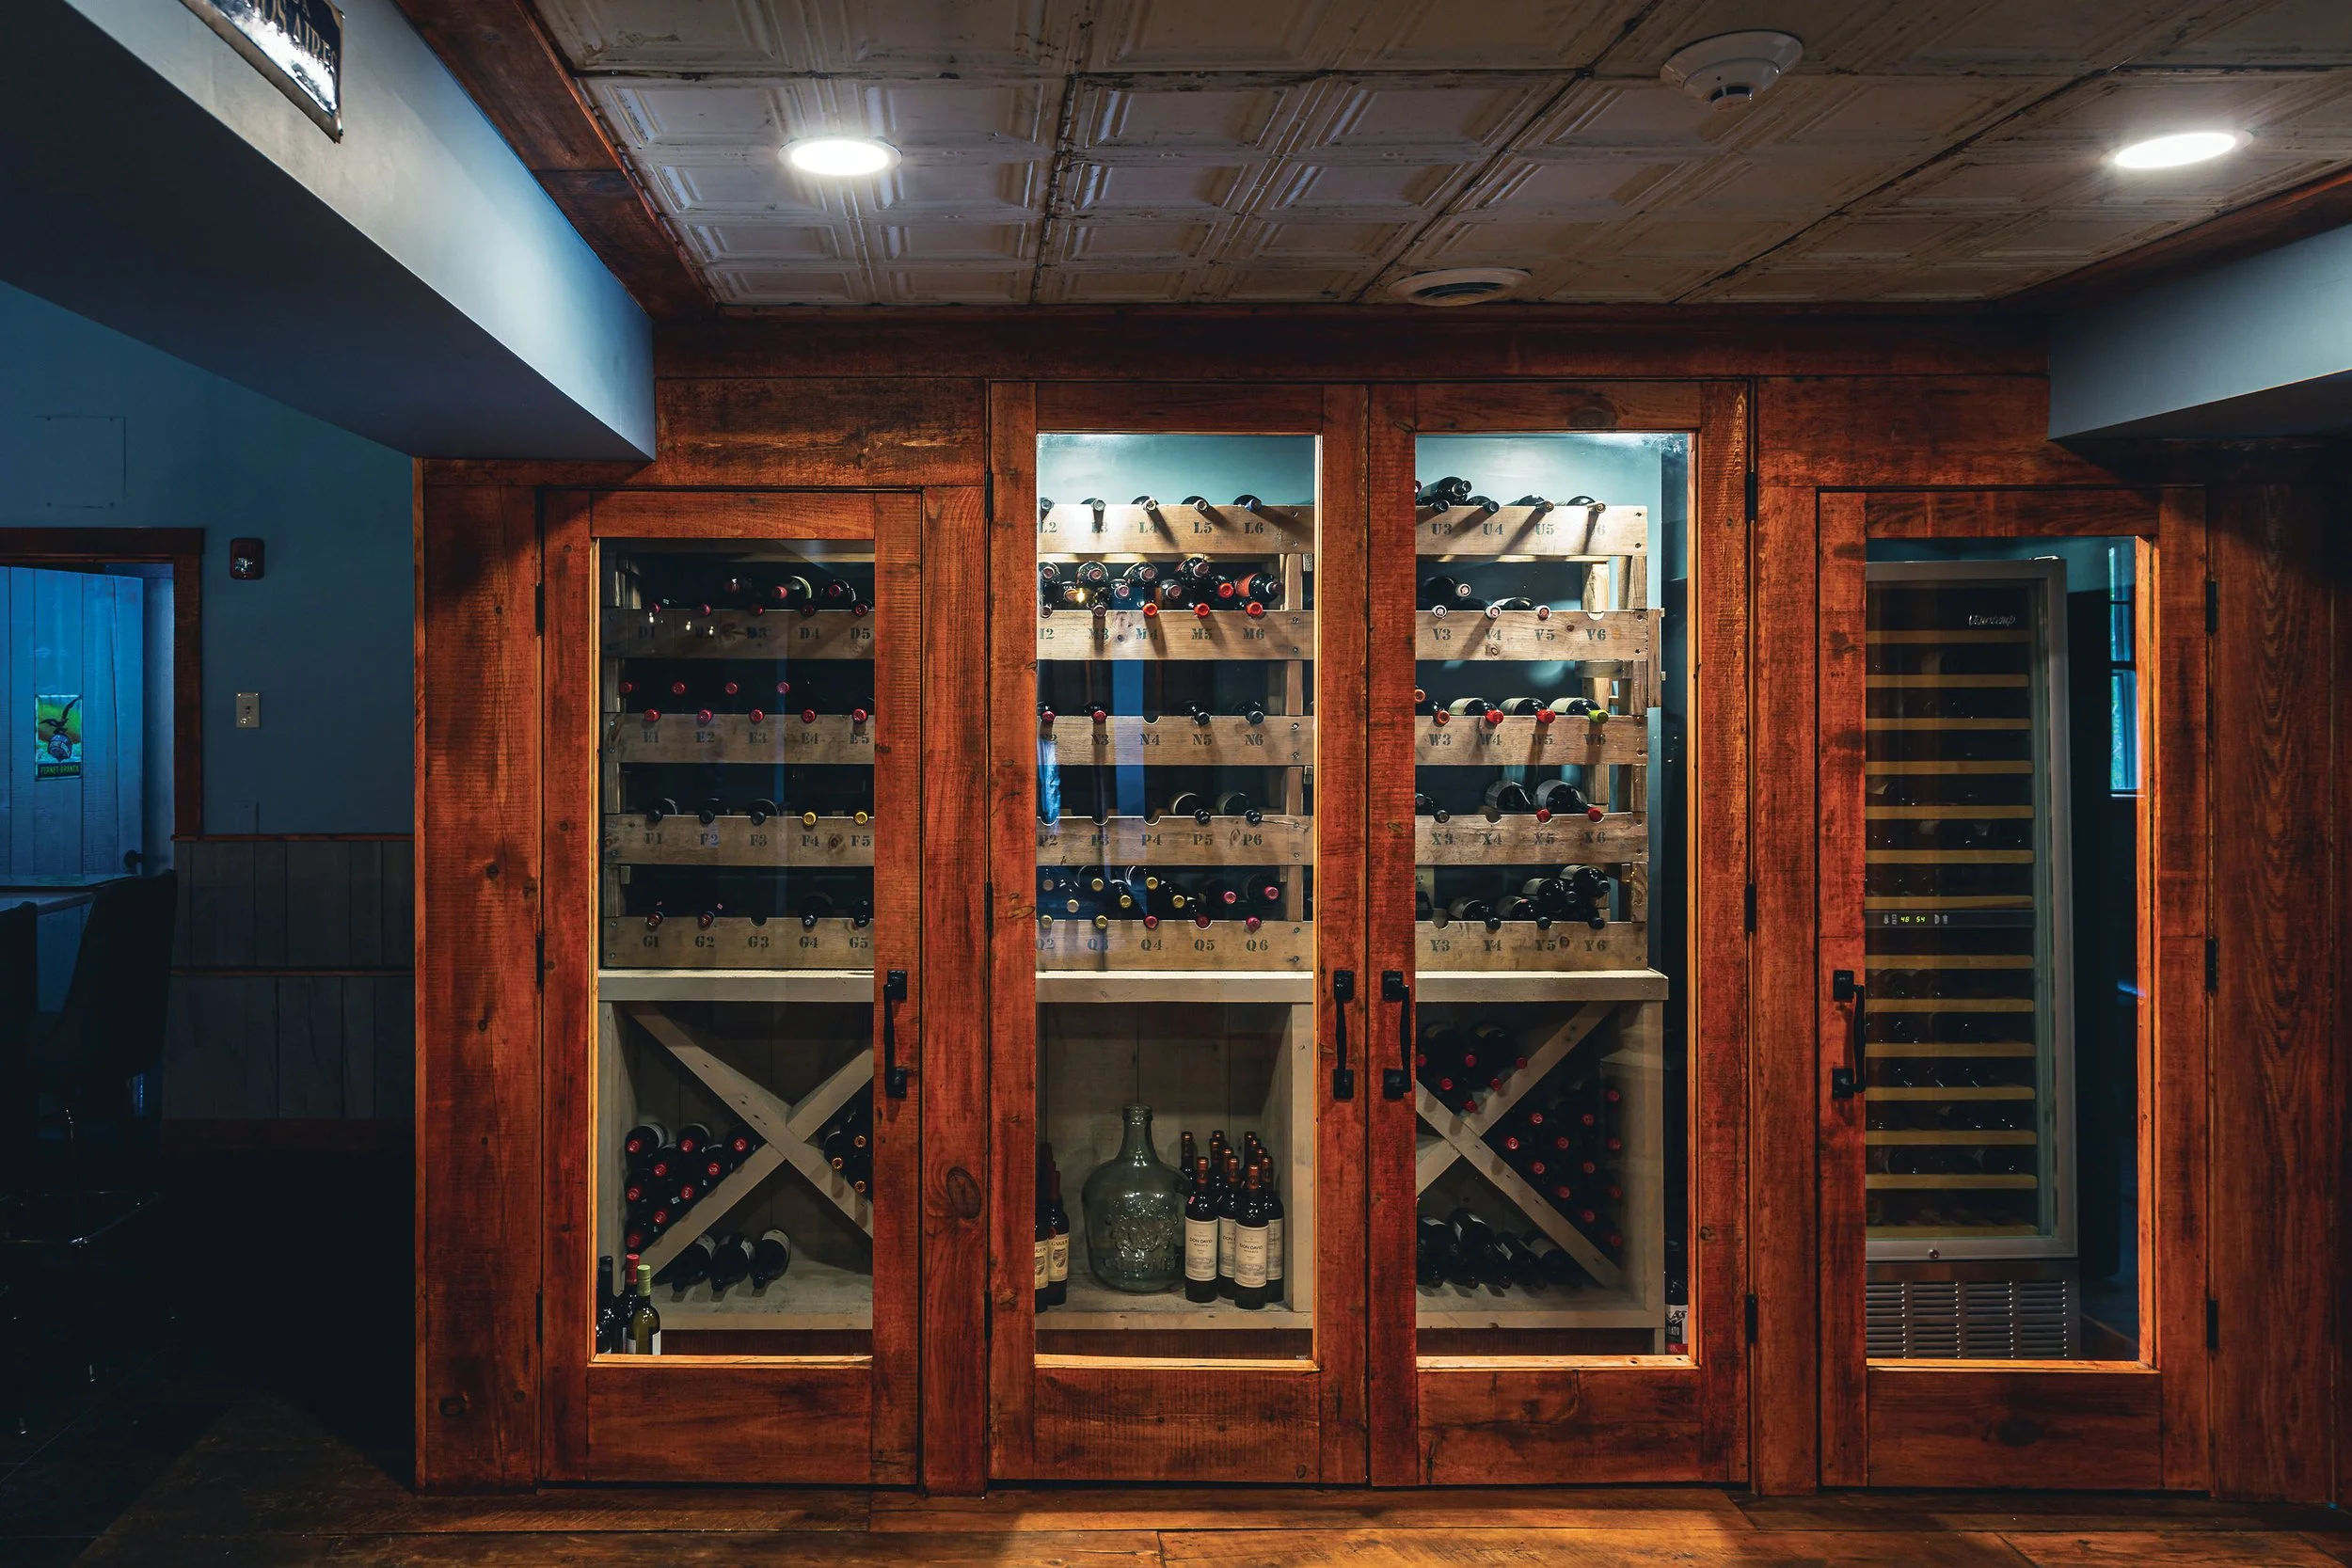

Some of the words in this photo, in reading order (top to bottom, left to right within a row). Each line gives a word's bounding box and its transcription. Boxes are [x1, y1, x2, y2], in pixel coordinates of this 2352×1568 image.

[1139, 522, 1158, 533] L4
[1194, 522, 1213, 533] L5
[1245, 522, 1263, 534] L6
[1432, 524, 1453, 535] U3
[1483, 524, 1503, 535] U4
[1535, 524, 1554, 535] U5
[638, 626, 655, 640] D1
[801, 626, 820, 640] D4
[850, 626, 871, 640] D5
[1089, 628, 1109, 640] M3
[1136, 628, 1158, 640] M4
[1192, 628, 1213, 640] M5
[1243, 628, 1264, 640] M6
[1433, 629, 1451, 640] V3
[1485, 629, 1502, 640] V4
[1535, 629, 1555, 640] V5
[1586, 629, 1606, 640] V6
[644, 731, 659, 743] E1
[696, 731, 715, 743] E2
[749, 731, 767, 743] E3
[801, 731, 818, 743] E4
[850, 731, 869, 743] E5
[1091, 734, 1109, 745] N3
[1139, 734, 1160, 745] N4
[1193, 734, 1212, 745] N5
[1245, 734, 1263, 745] N6
[1429, 734, 1451, 745] W3
[1479, 734, 1502, 745] W4
[1532, 734, 1553, 745] W5
[1584, 734, 1606, 745] W6
[644, 833, 661, 846] F1
[700, 833, 719, 847] F2
[750, 833, 767, 847] F3
[802, 833, 819, 847] F4
[851, 833, 870, 847] F5
[1141, 834, 1161, 846] P4
[1193, 834, 1213, 846] P5
[1243, 834, 1263, 846] P6
[1431, 833, 1454, 845] X3
[1483, 833, 1502, 845] X4
[1534, 833, 1554, 845] X5
[1584, 832, 1606, 844] X6
[643, 936, 660, 948] G1
[695, 936, 715, 948] G2
[748, 936, 770, 948] G3
[799, 936, 818, 948] G4
[849, 936, 868, 948] G5
[1141, 940, 1162, 951] Q4
[1195, 940, 1215, 951] Q5
[1247, 940, 1268, 951] Q6
[1430, 940, 1451, 951] Y3
[1484, 940, 1502, 951] Y4
[1535, 940, 1555, 951] Y5
[1584, 940, 1606, 951] Y6
